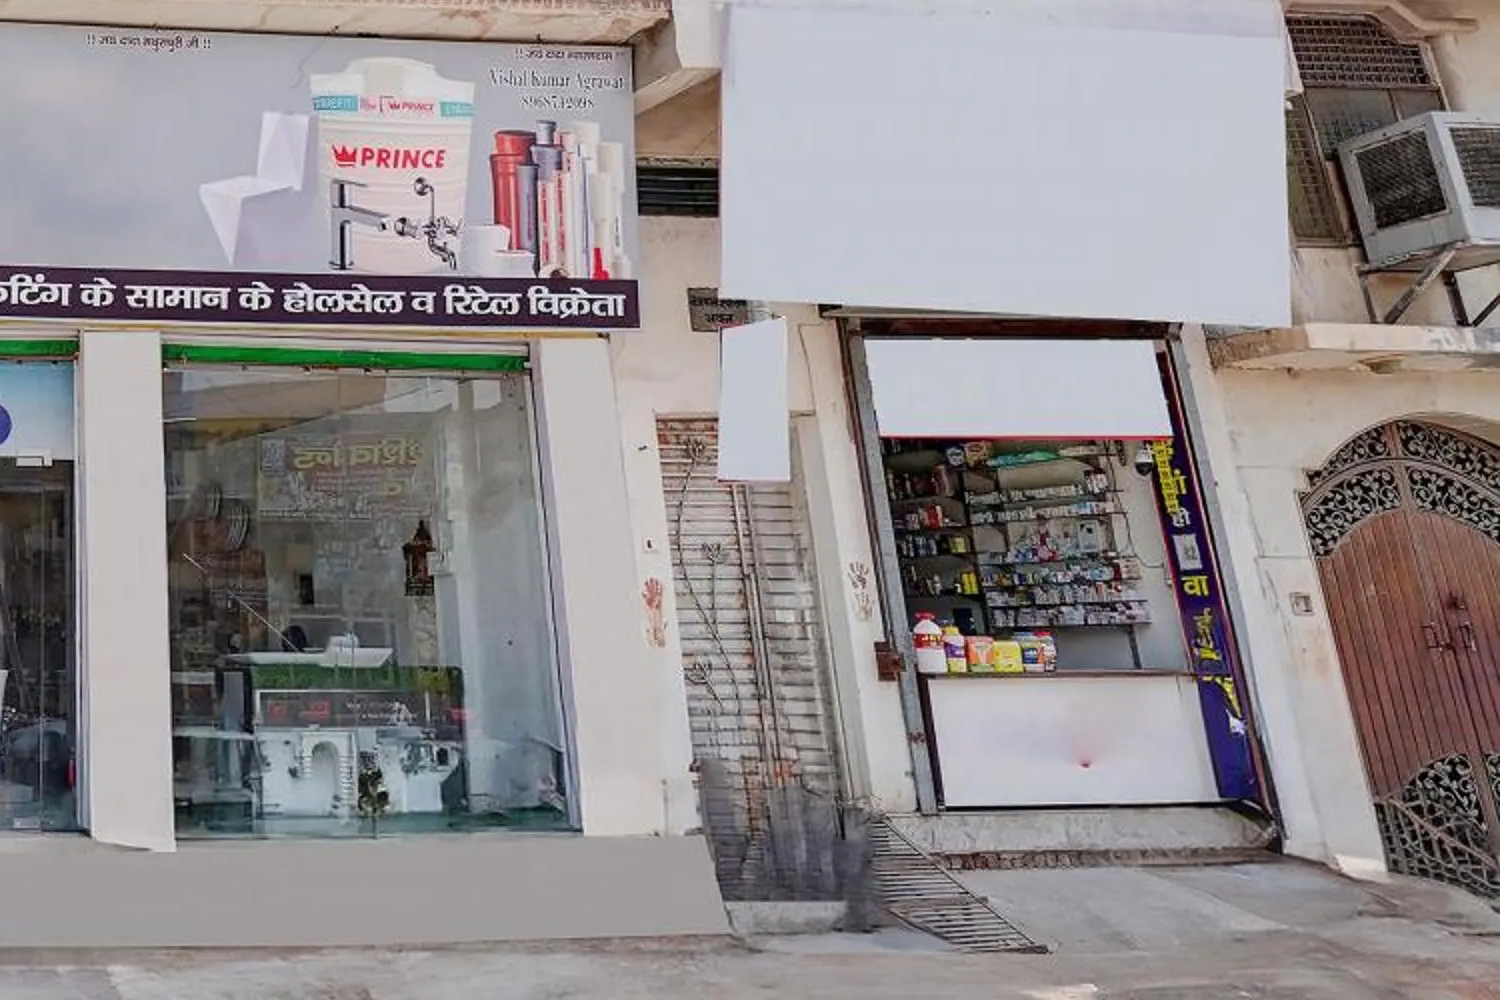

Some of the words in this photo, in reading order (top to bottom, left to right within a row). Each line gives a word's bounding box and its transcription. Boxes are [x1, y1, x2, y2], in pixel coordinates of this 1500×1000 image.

[489, 68, 528, 87] Vishal
[361, 147, 446, 169] PRINCE
[80, 277, 116, 309] के
[125, 284, 230, 311] सामान
[238, 281, 274, 312] के
[283, 281, 405, 314] होलसेल
[411, 291, 435, 315] व
[443, 284, 521, 317] रिटेल
[528, 285, 626, 318] विक्रेता
